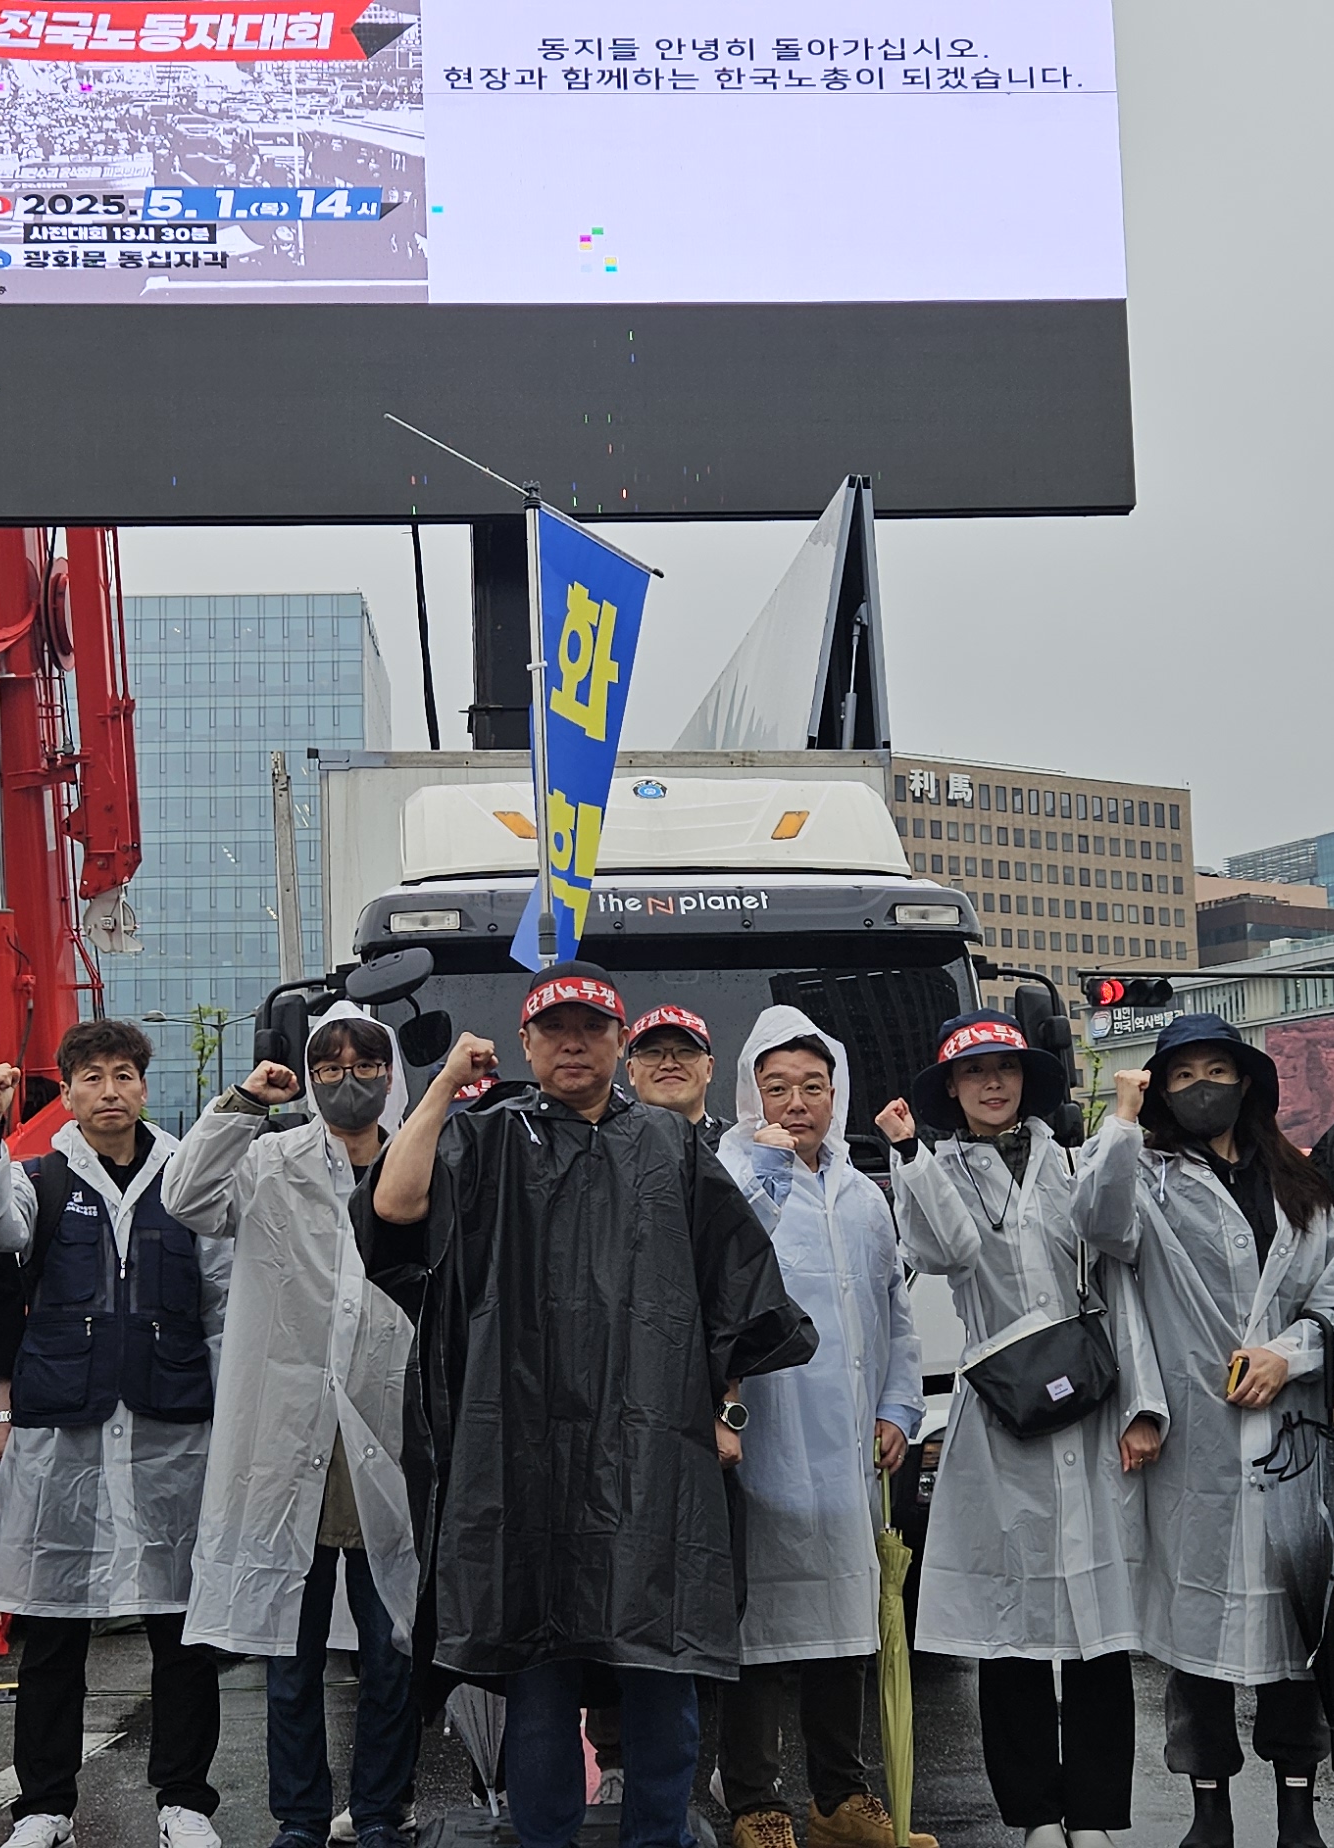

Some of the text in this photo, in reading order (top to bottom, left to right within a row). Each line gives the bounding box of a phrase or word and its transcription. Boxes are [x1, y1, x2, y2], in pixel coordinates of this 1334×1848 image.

[537, 37, 990, 61] 동지들 안녕히 돌아가십시오.
[443, 66, 1084, 91] 현장과 함께하는 한국노총이 되겠습니다.
[29, 226, 210, 242] 사전대회 13시 30분
[22, 250, 230, 269] 광화문 동십자각
[598, 894, 642, 912] the
[679, 892, 768, 915] planet
[526, 980, 616, 1017] 단결 투쟁
[943, 1029, 973, 1060] 단결
